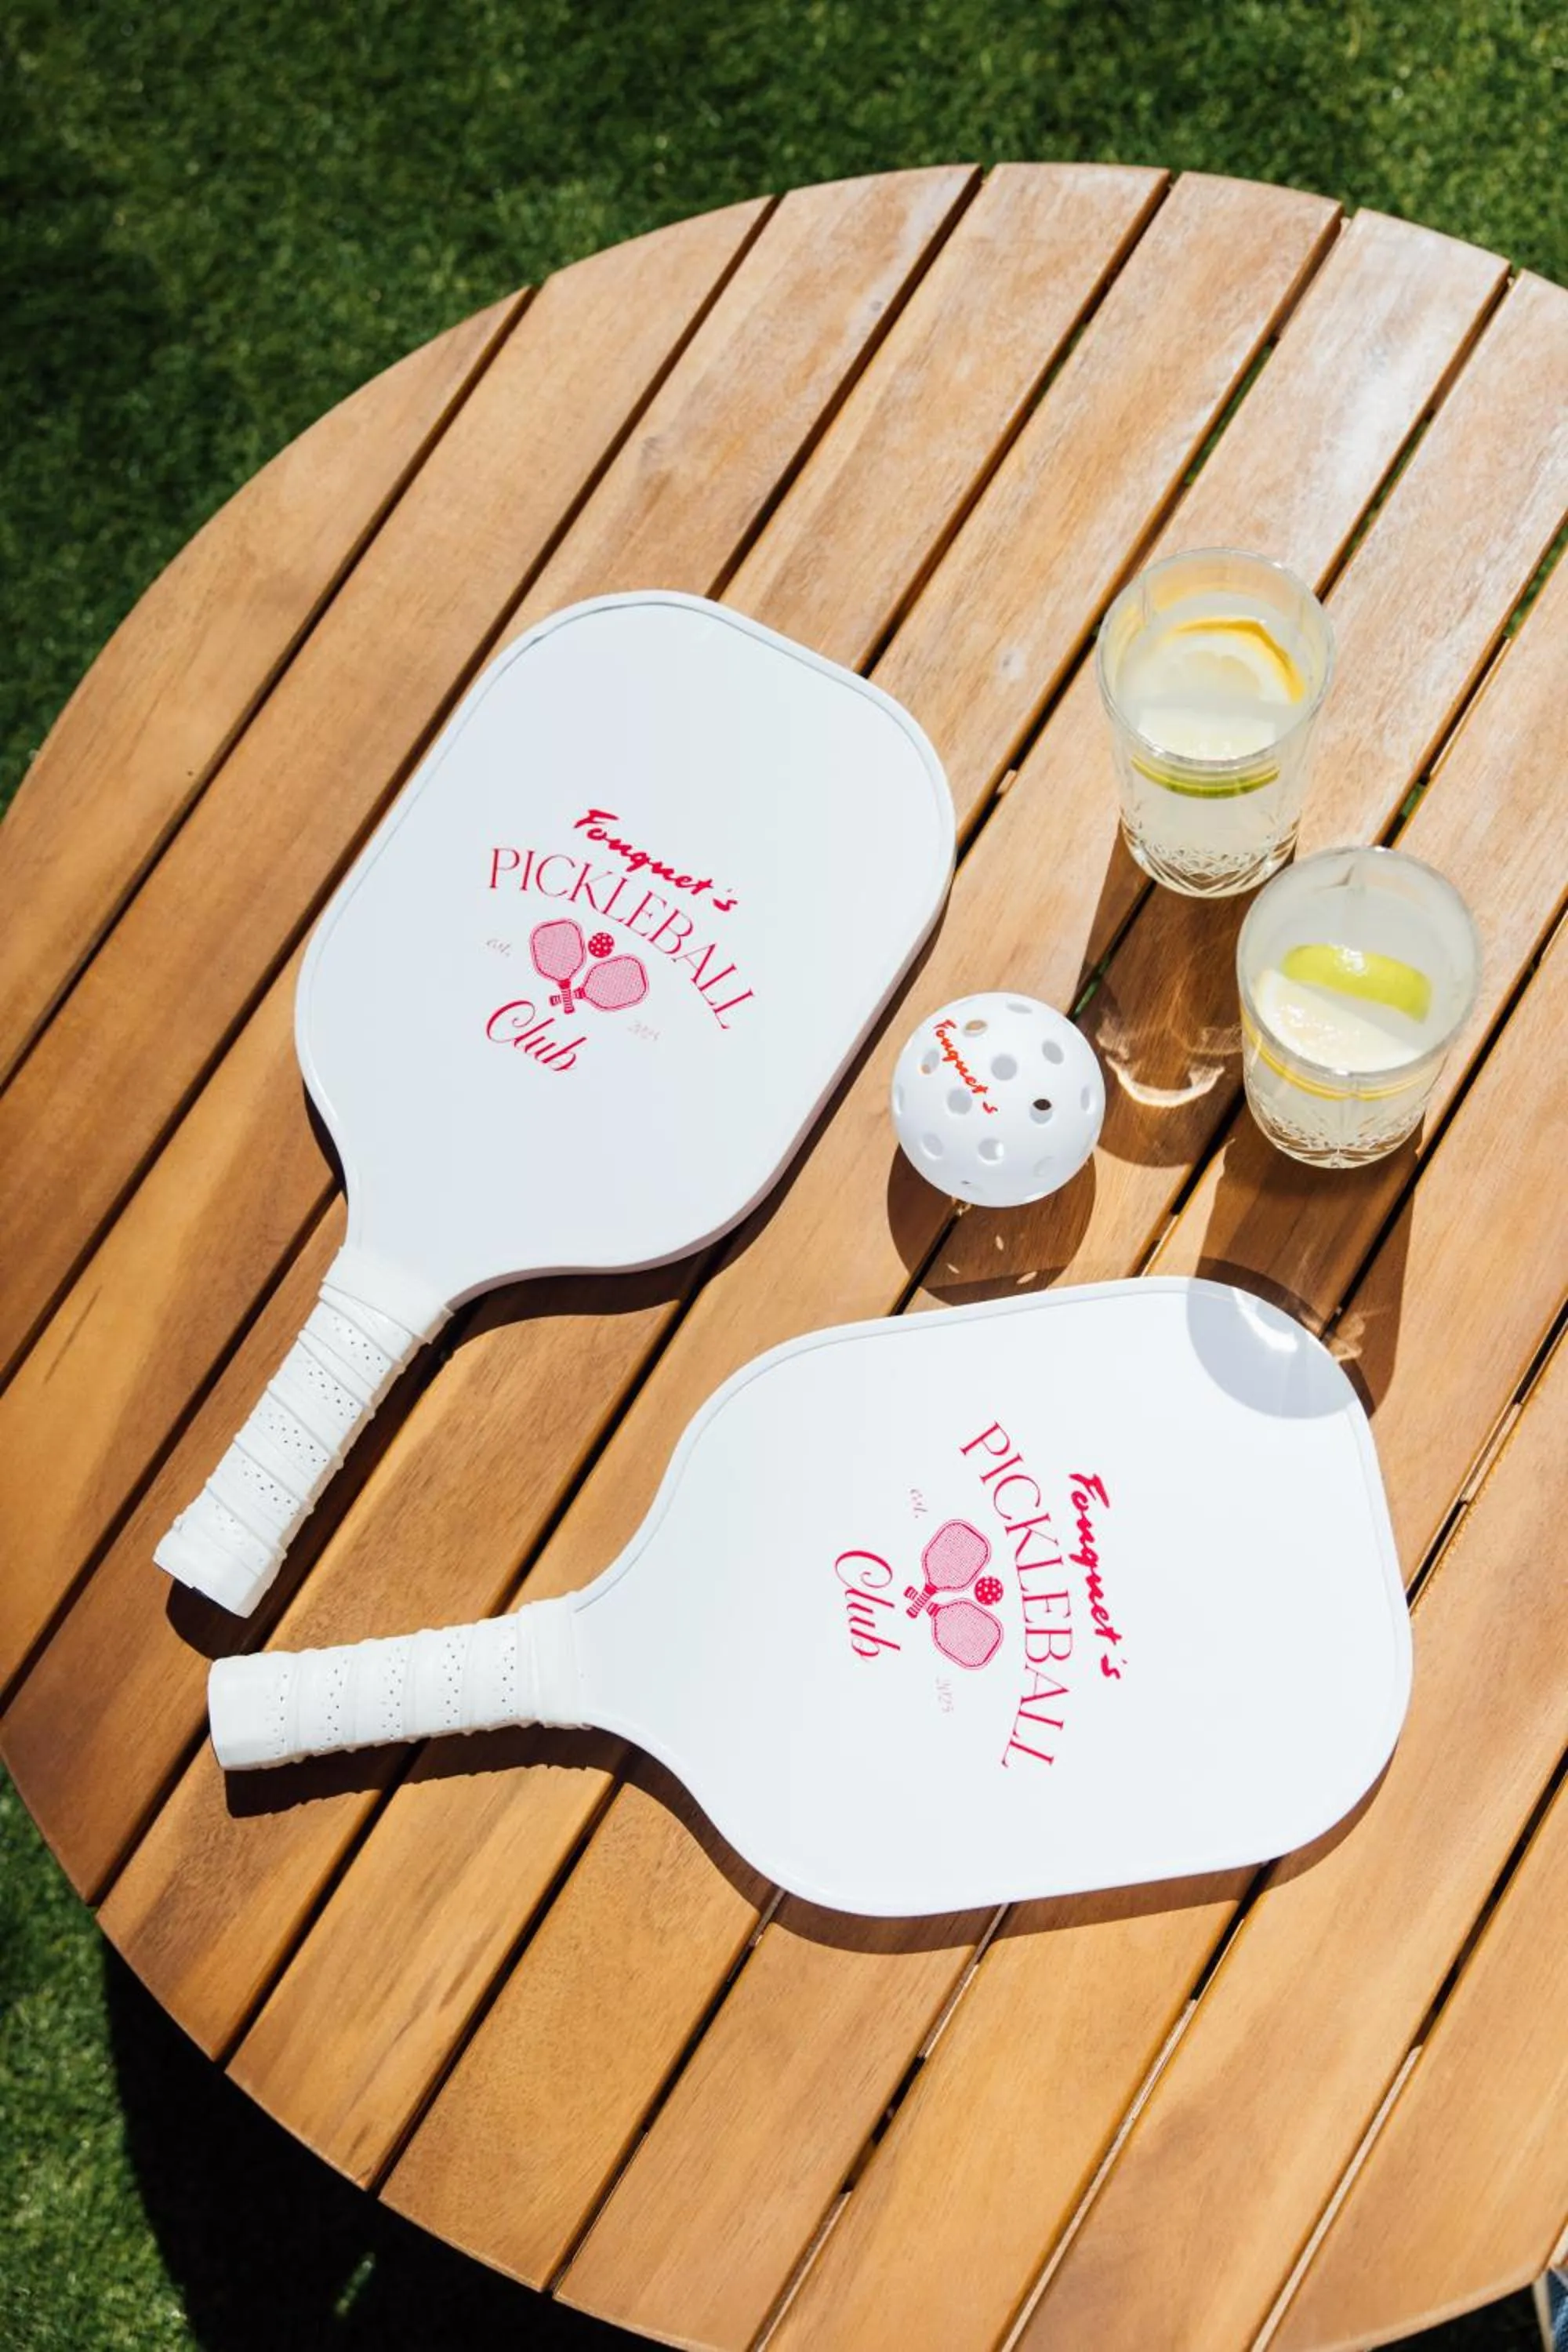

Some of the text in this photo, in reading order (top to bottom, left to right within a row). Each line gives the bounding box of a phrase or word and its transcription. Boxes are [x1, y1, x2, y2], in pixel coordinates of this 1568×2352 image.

[573, 808, 740, 913] Fouquet's
[488, 847, 756, 1030] PICKLEBALL
[485, 998, 589, 1073] Club
[933, 1018, 1000, 1116] Fouquets
[833, 1548, 902, 1662] Club
[959, 1421, 1074, 1769] PICKLEBALL
[1068, 1472, 1129, 1681] Fouquet's
